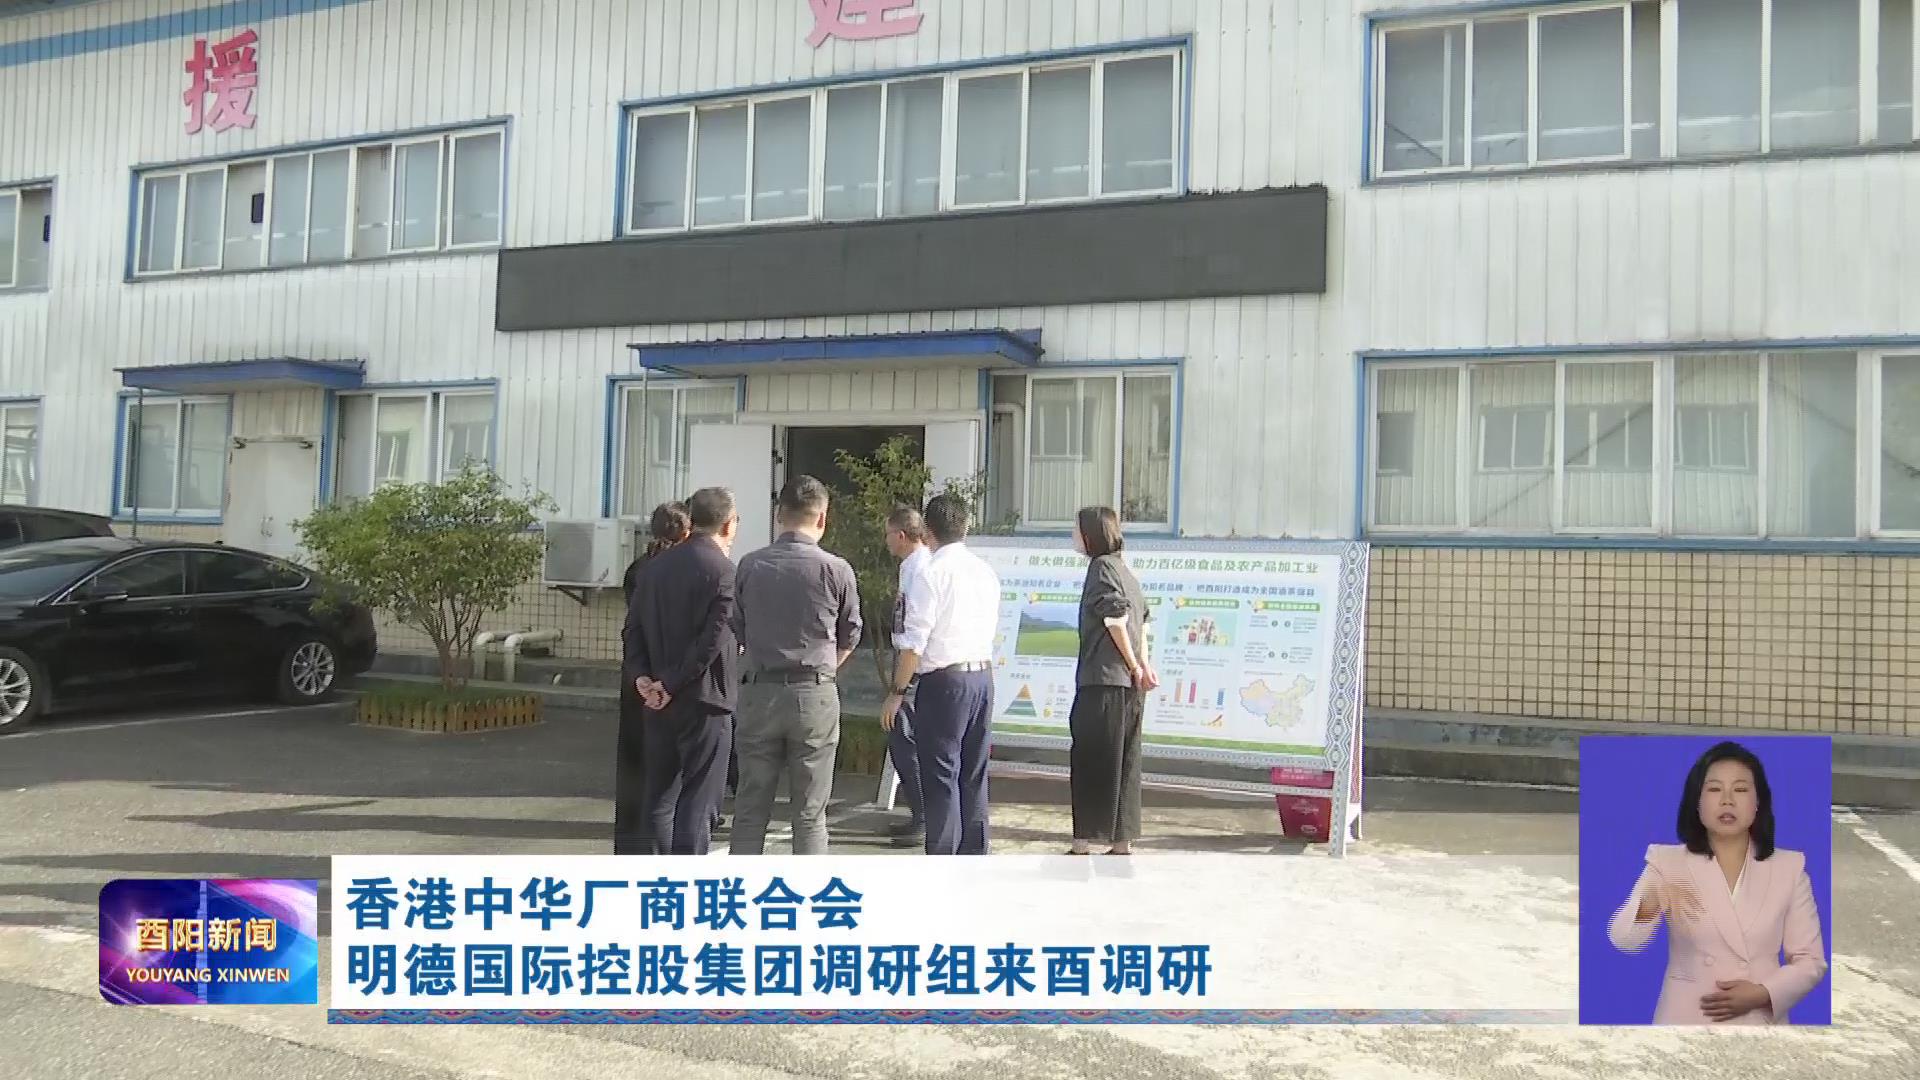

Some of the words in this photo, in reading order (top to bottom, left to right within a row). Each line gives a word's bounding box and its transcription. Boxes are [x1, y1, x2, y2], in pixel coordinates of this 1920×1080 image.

[184, 29, 259, 135] 援
[1132, 557, 1319, 574] 助力百亿级食品及农产品加工业
